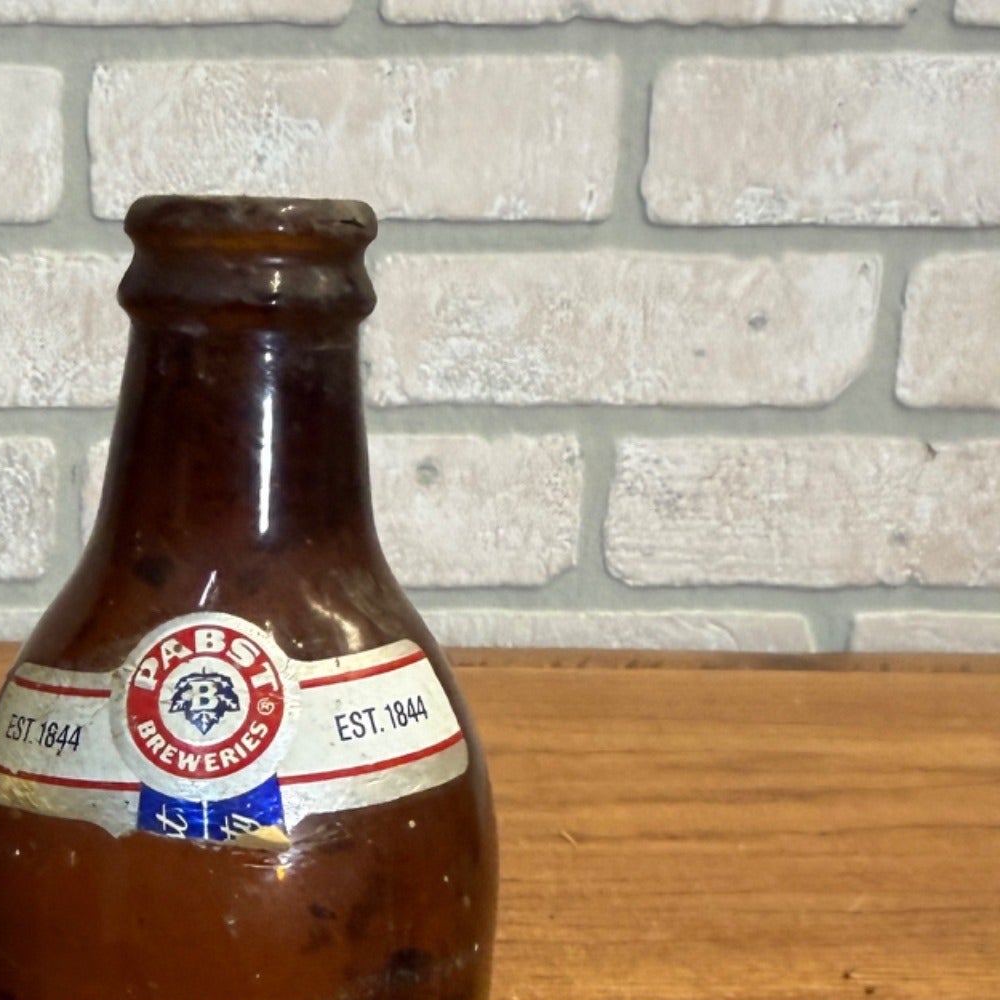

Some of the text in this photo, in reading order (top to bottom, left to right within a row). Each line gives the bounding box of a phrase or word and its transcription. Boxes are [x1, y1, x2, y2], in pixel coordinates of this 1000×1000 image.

[134, 629, 279, 692] PABST
[189, 681, 219, 711] B
[335, 696, 429, 741] EST. 1844
[5, 714, 81, 753] EST. 1844
[137, 719, 268, 772] BREWERIES
